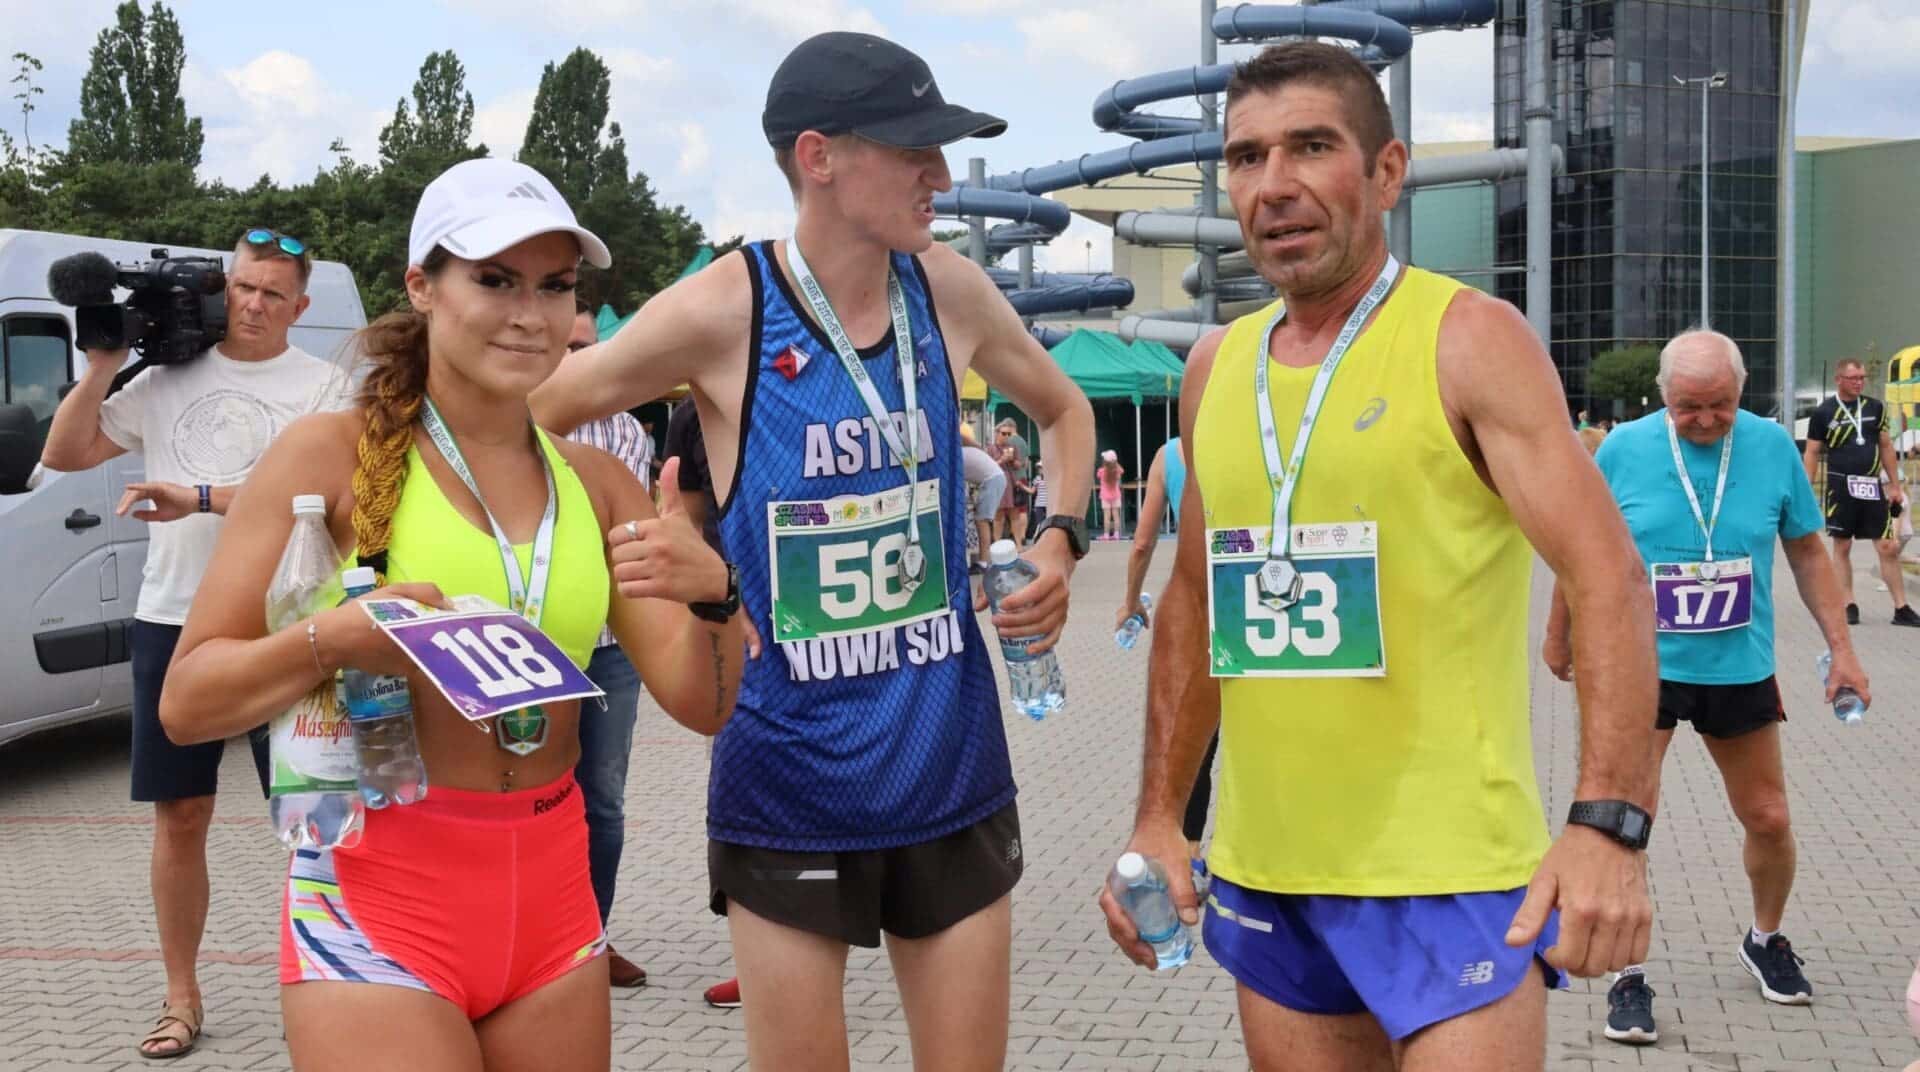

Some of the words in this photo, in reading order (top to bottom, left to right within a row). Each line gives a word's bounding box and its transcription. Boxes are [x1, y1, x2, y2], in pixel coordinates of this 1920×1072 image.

[804, 408, 935, 478] ASTRA
[1851, 483, 1876, 498] 160
[818, 532, 915, 619] 56
[1672, 582, 1738, 624] 177
[1245, 571, 1341, 657] 53
[430, 623, 563, 698] 118
[782, 628, 900, 681] NOWA
